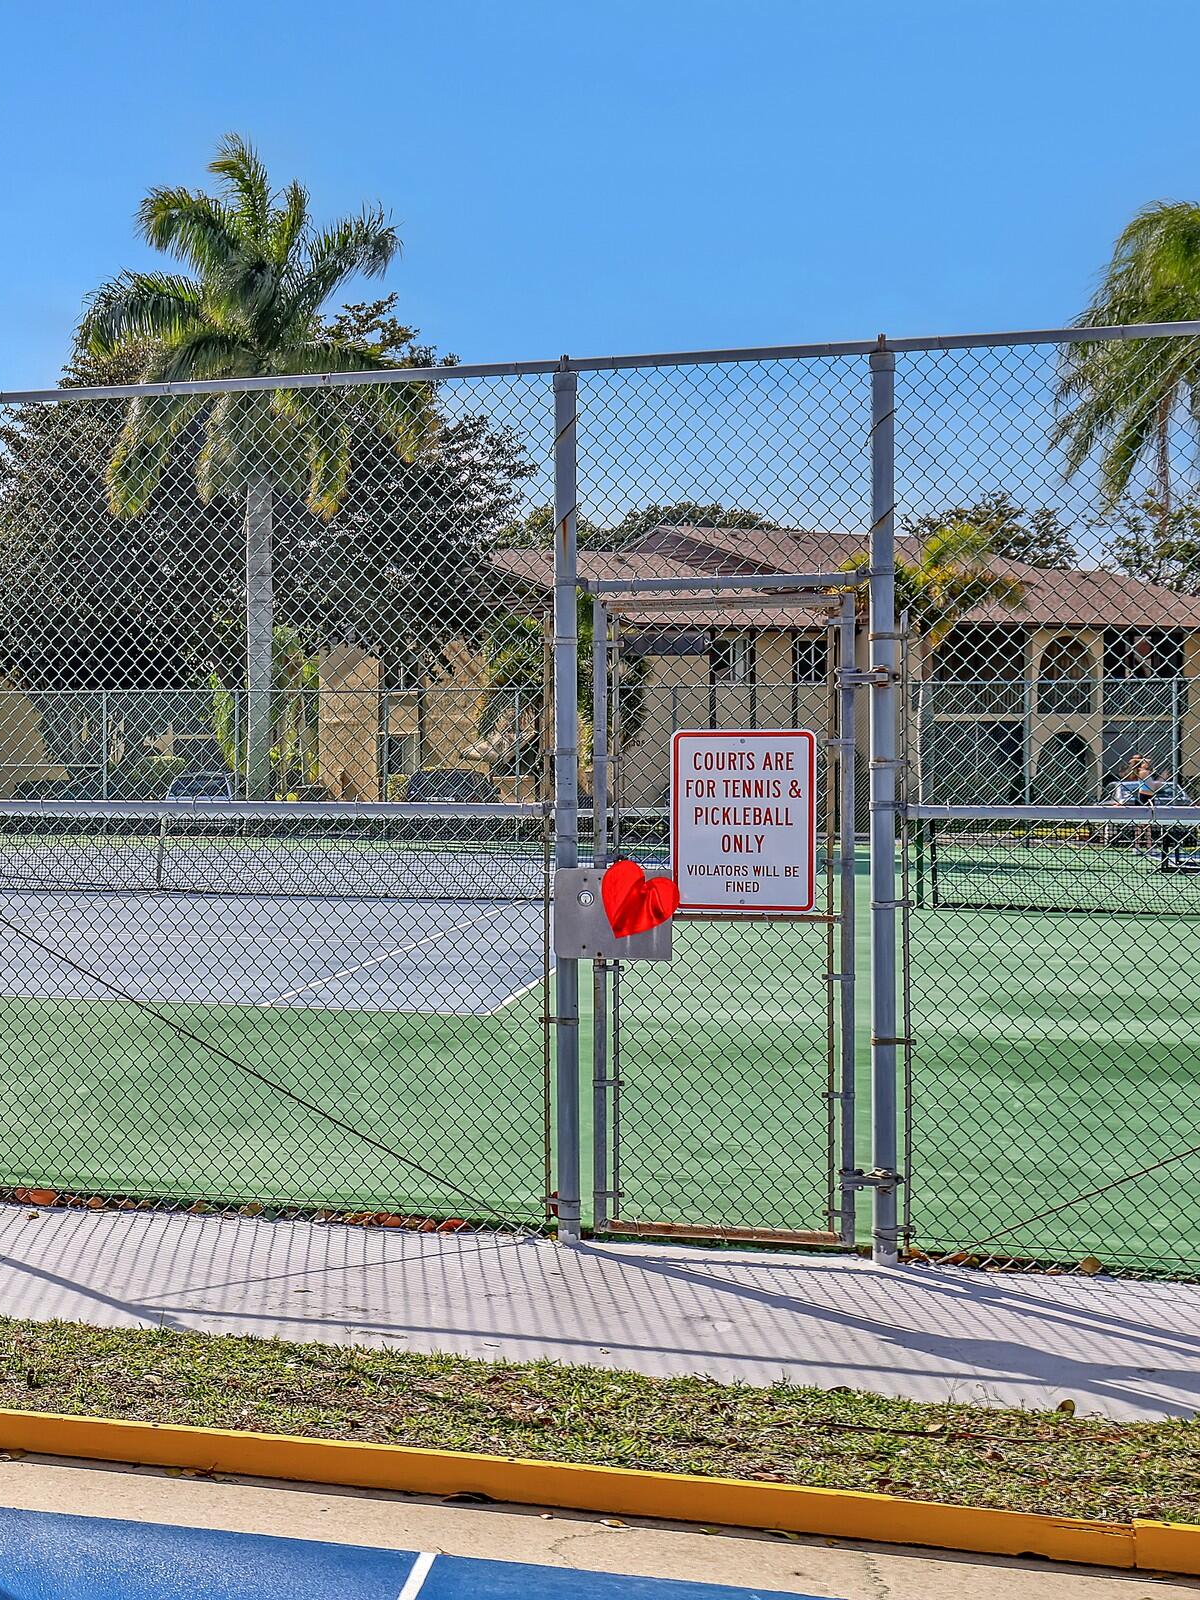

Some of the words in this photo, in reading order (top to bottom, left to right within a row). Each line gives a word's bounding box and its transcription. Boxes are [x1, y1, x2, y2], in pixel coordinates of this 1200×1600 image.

[693, 751, 756, 771] COURTS
[762, 751, 795, 771] ARE
[685, 779, 716, 798] FOR
[722, 779, 782, 799] TENNIS
[788, 779, 803, 799] &
[694, 806, 794, 826] PICKLEBALL
[721, 834, 765, 854] ONLY
[686, 864, 749, 877] VIOLATORS
[752, 865, 780, 878] WILL
[784, 866, 800, 878] BE
[725, 880, 760, 893] FINED
